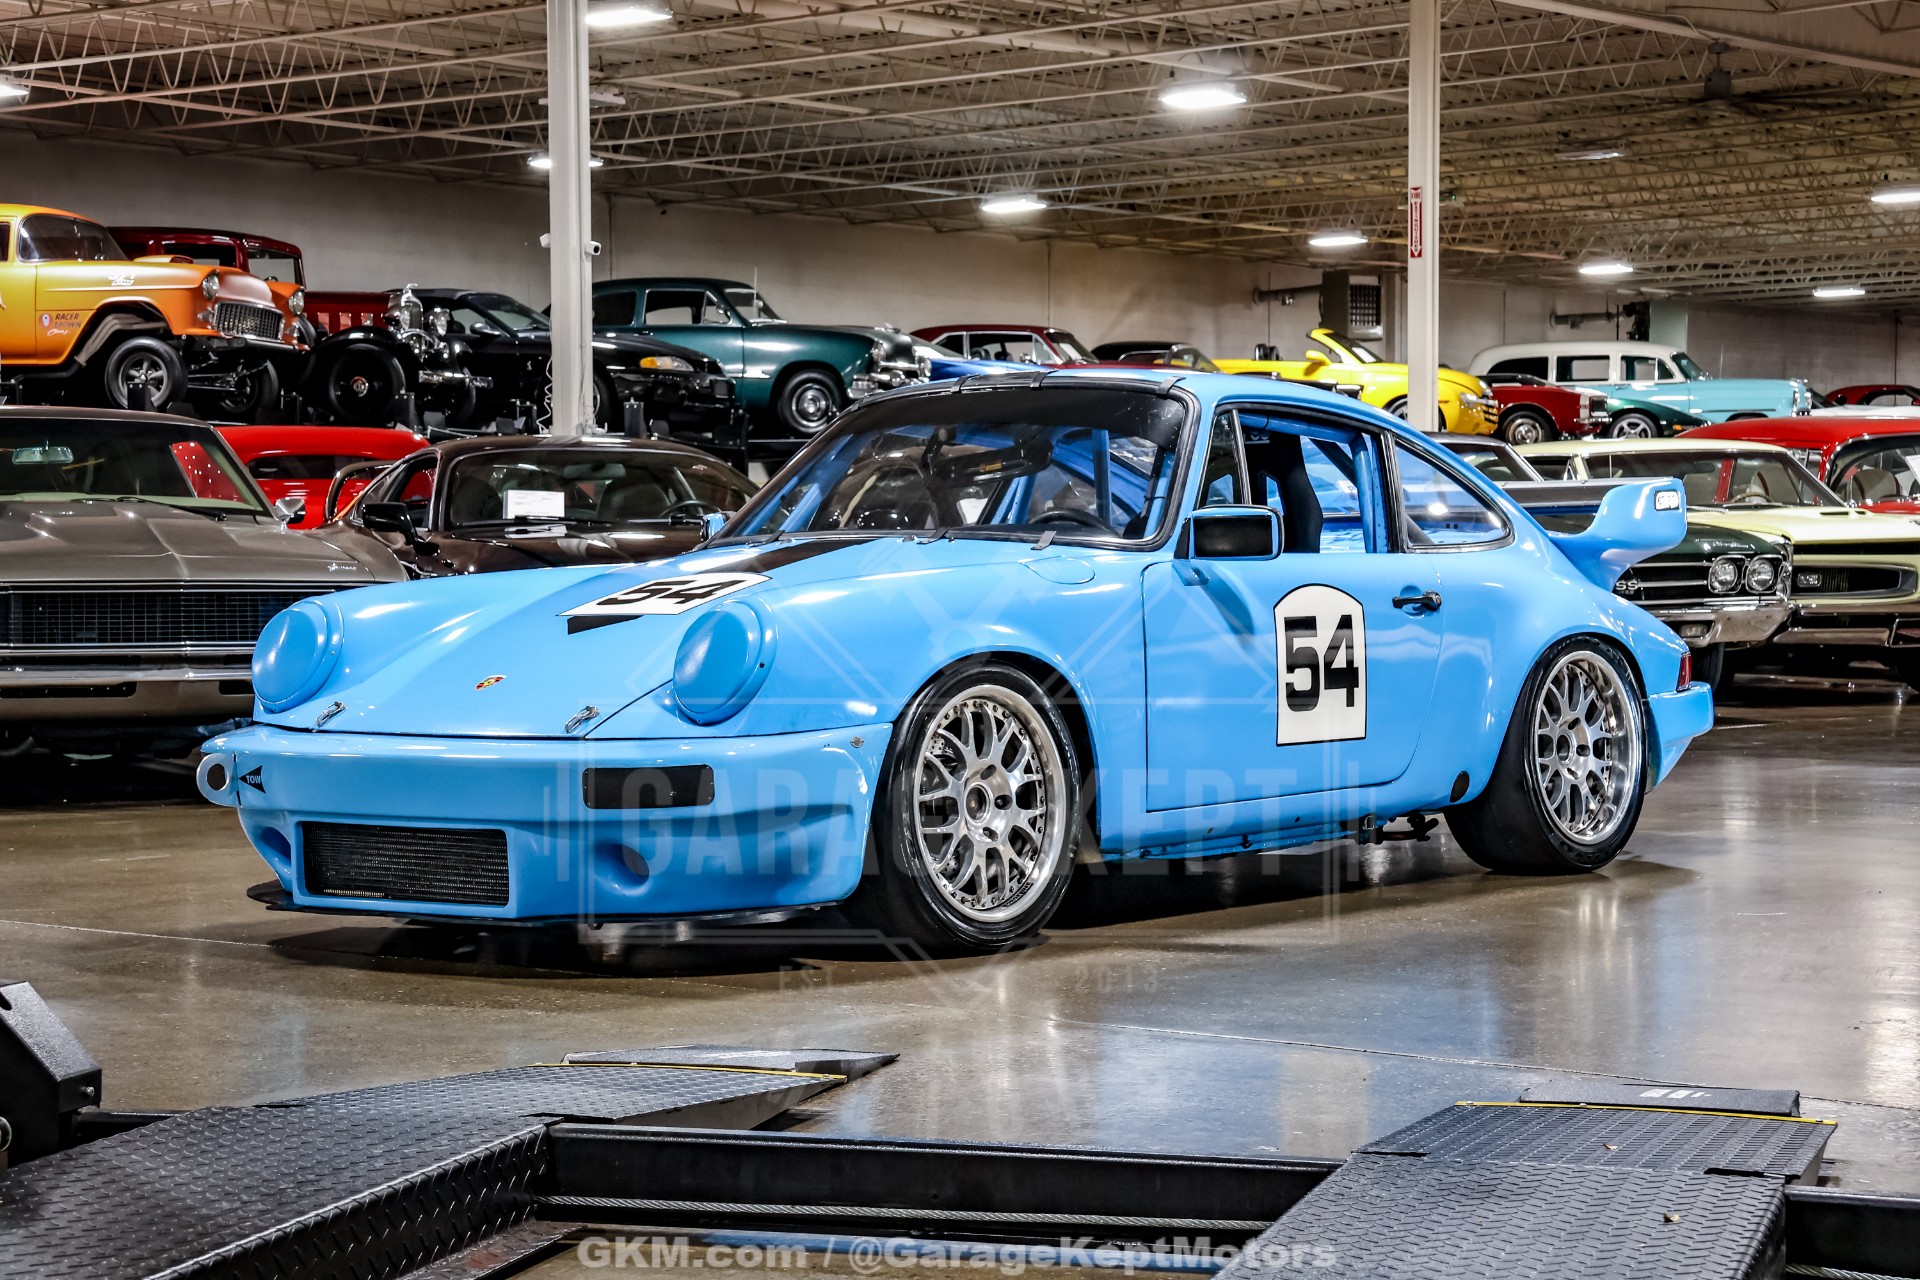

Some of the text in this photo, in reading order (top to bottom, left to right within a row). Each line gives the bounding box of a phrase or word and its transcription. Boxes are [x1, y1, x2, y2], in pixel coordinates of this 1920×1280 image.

[596, 580, 748, 605] 54
[1615, 580, 1639, 591] SS
[1283, 614, 1360, 713] 54
[245, 774, 261, 784] TOW
